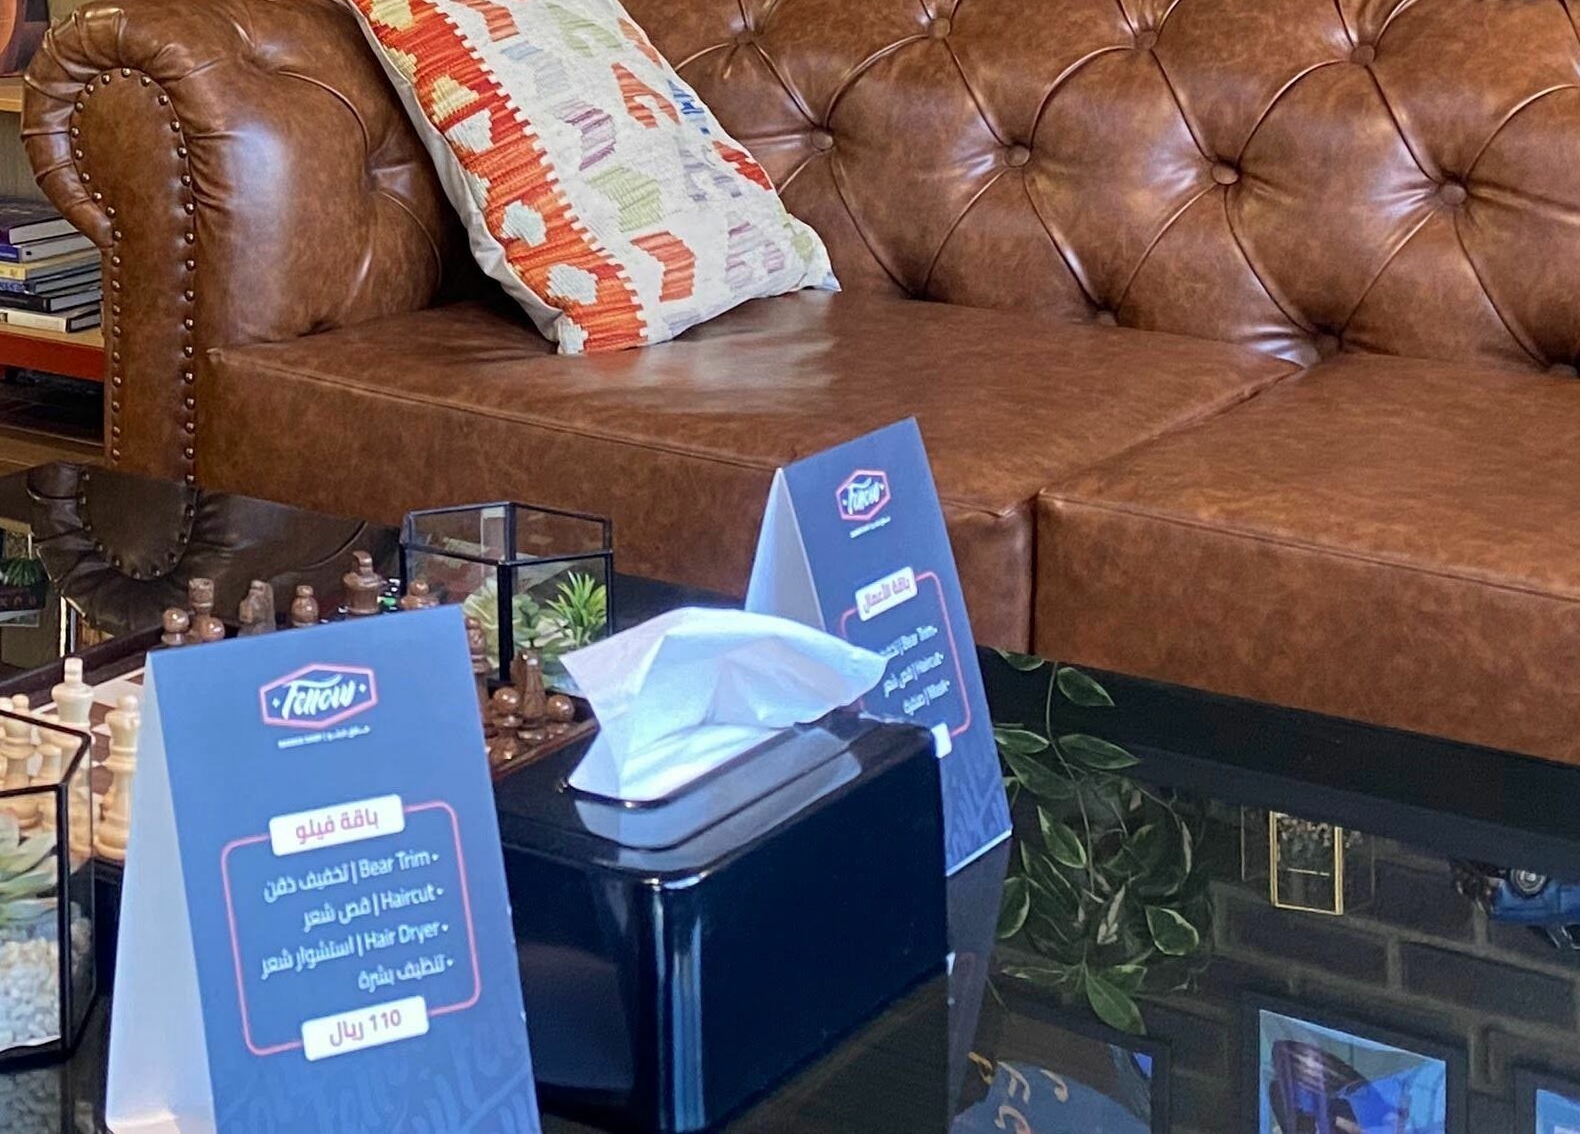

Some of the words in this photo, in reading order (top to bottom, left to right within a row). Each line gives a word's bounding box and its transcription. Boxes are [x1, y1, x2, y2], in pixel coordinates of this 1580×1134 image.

[281, 673, 356, 720] Fellow
[296, 815, 335, 845] فيلو
[340, 808, 379, 830] باقة
[359, 857, 393, 879] Bear
[395, 850, 430, 871] Trim
[381, 883, 436, 910] Haircut
[303, 902, 336, 933] شعر
[364, 928, 395, 950] Hair
[398, 921, 440, 944] Dryer
[261, 947, 294, 980] شعر
[369, 1009, 402, 1031] 110
[329, 1021, 364, 1047] ريال
